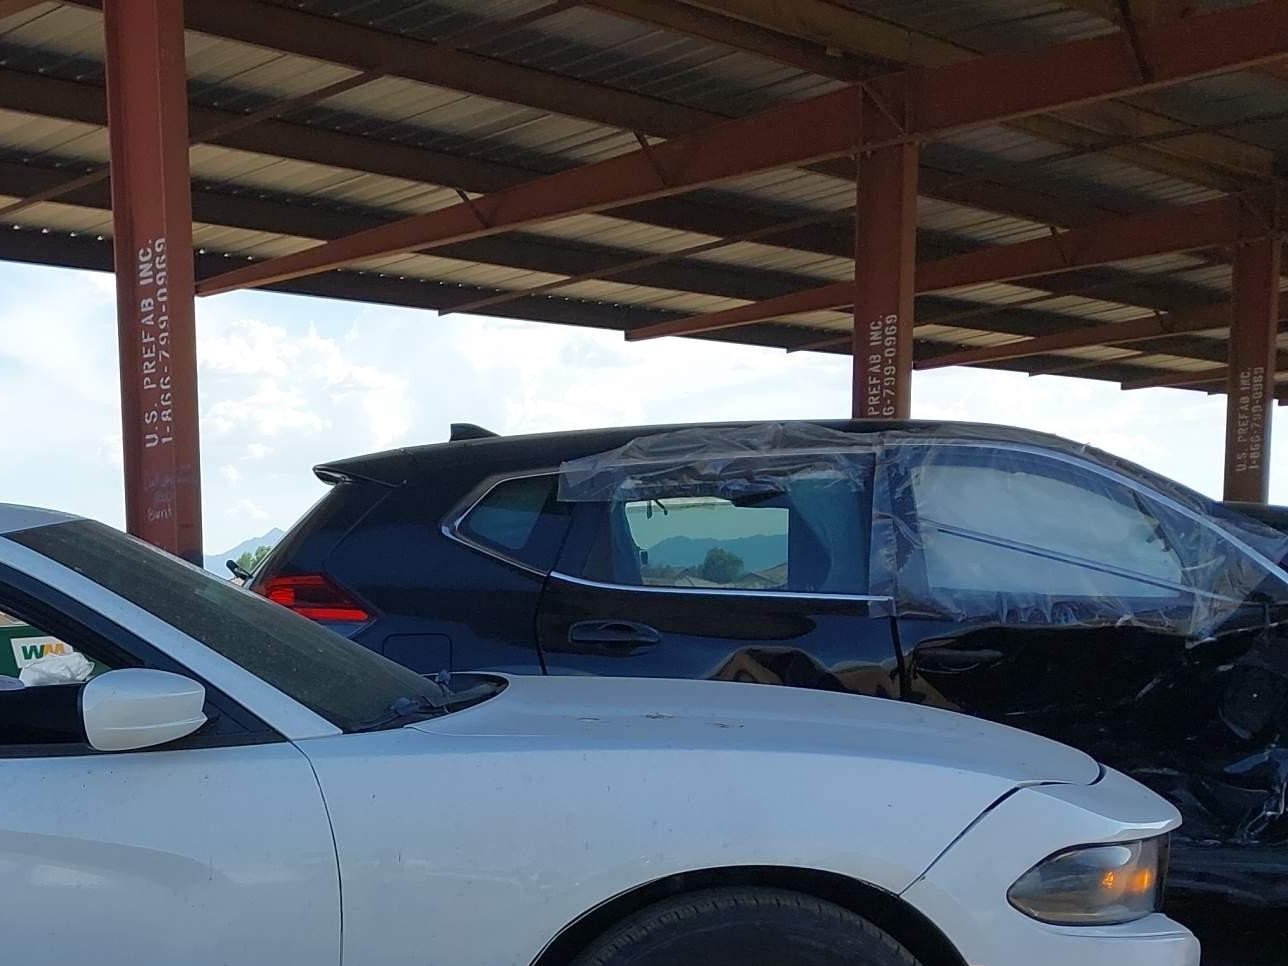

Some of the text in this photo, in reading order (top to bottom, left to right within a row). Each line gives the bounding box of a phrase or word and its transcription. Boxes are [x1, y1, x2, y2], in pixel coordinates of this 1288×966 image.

[138, 240, 159, 448] U.S. PREFAB INC.
[868, 315, 883, 416] PREFAB INC.
[1237, 396, 1250, 442] PREFAB
